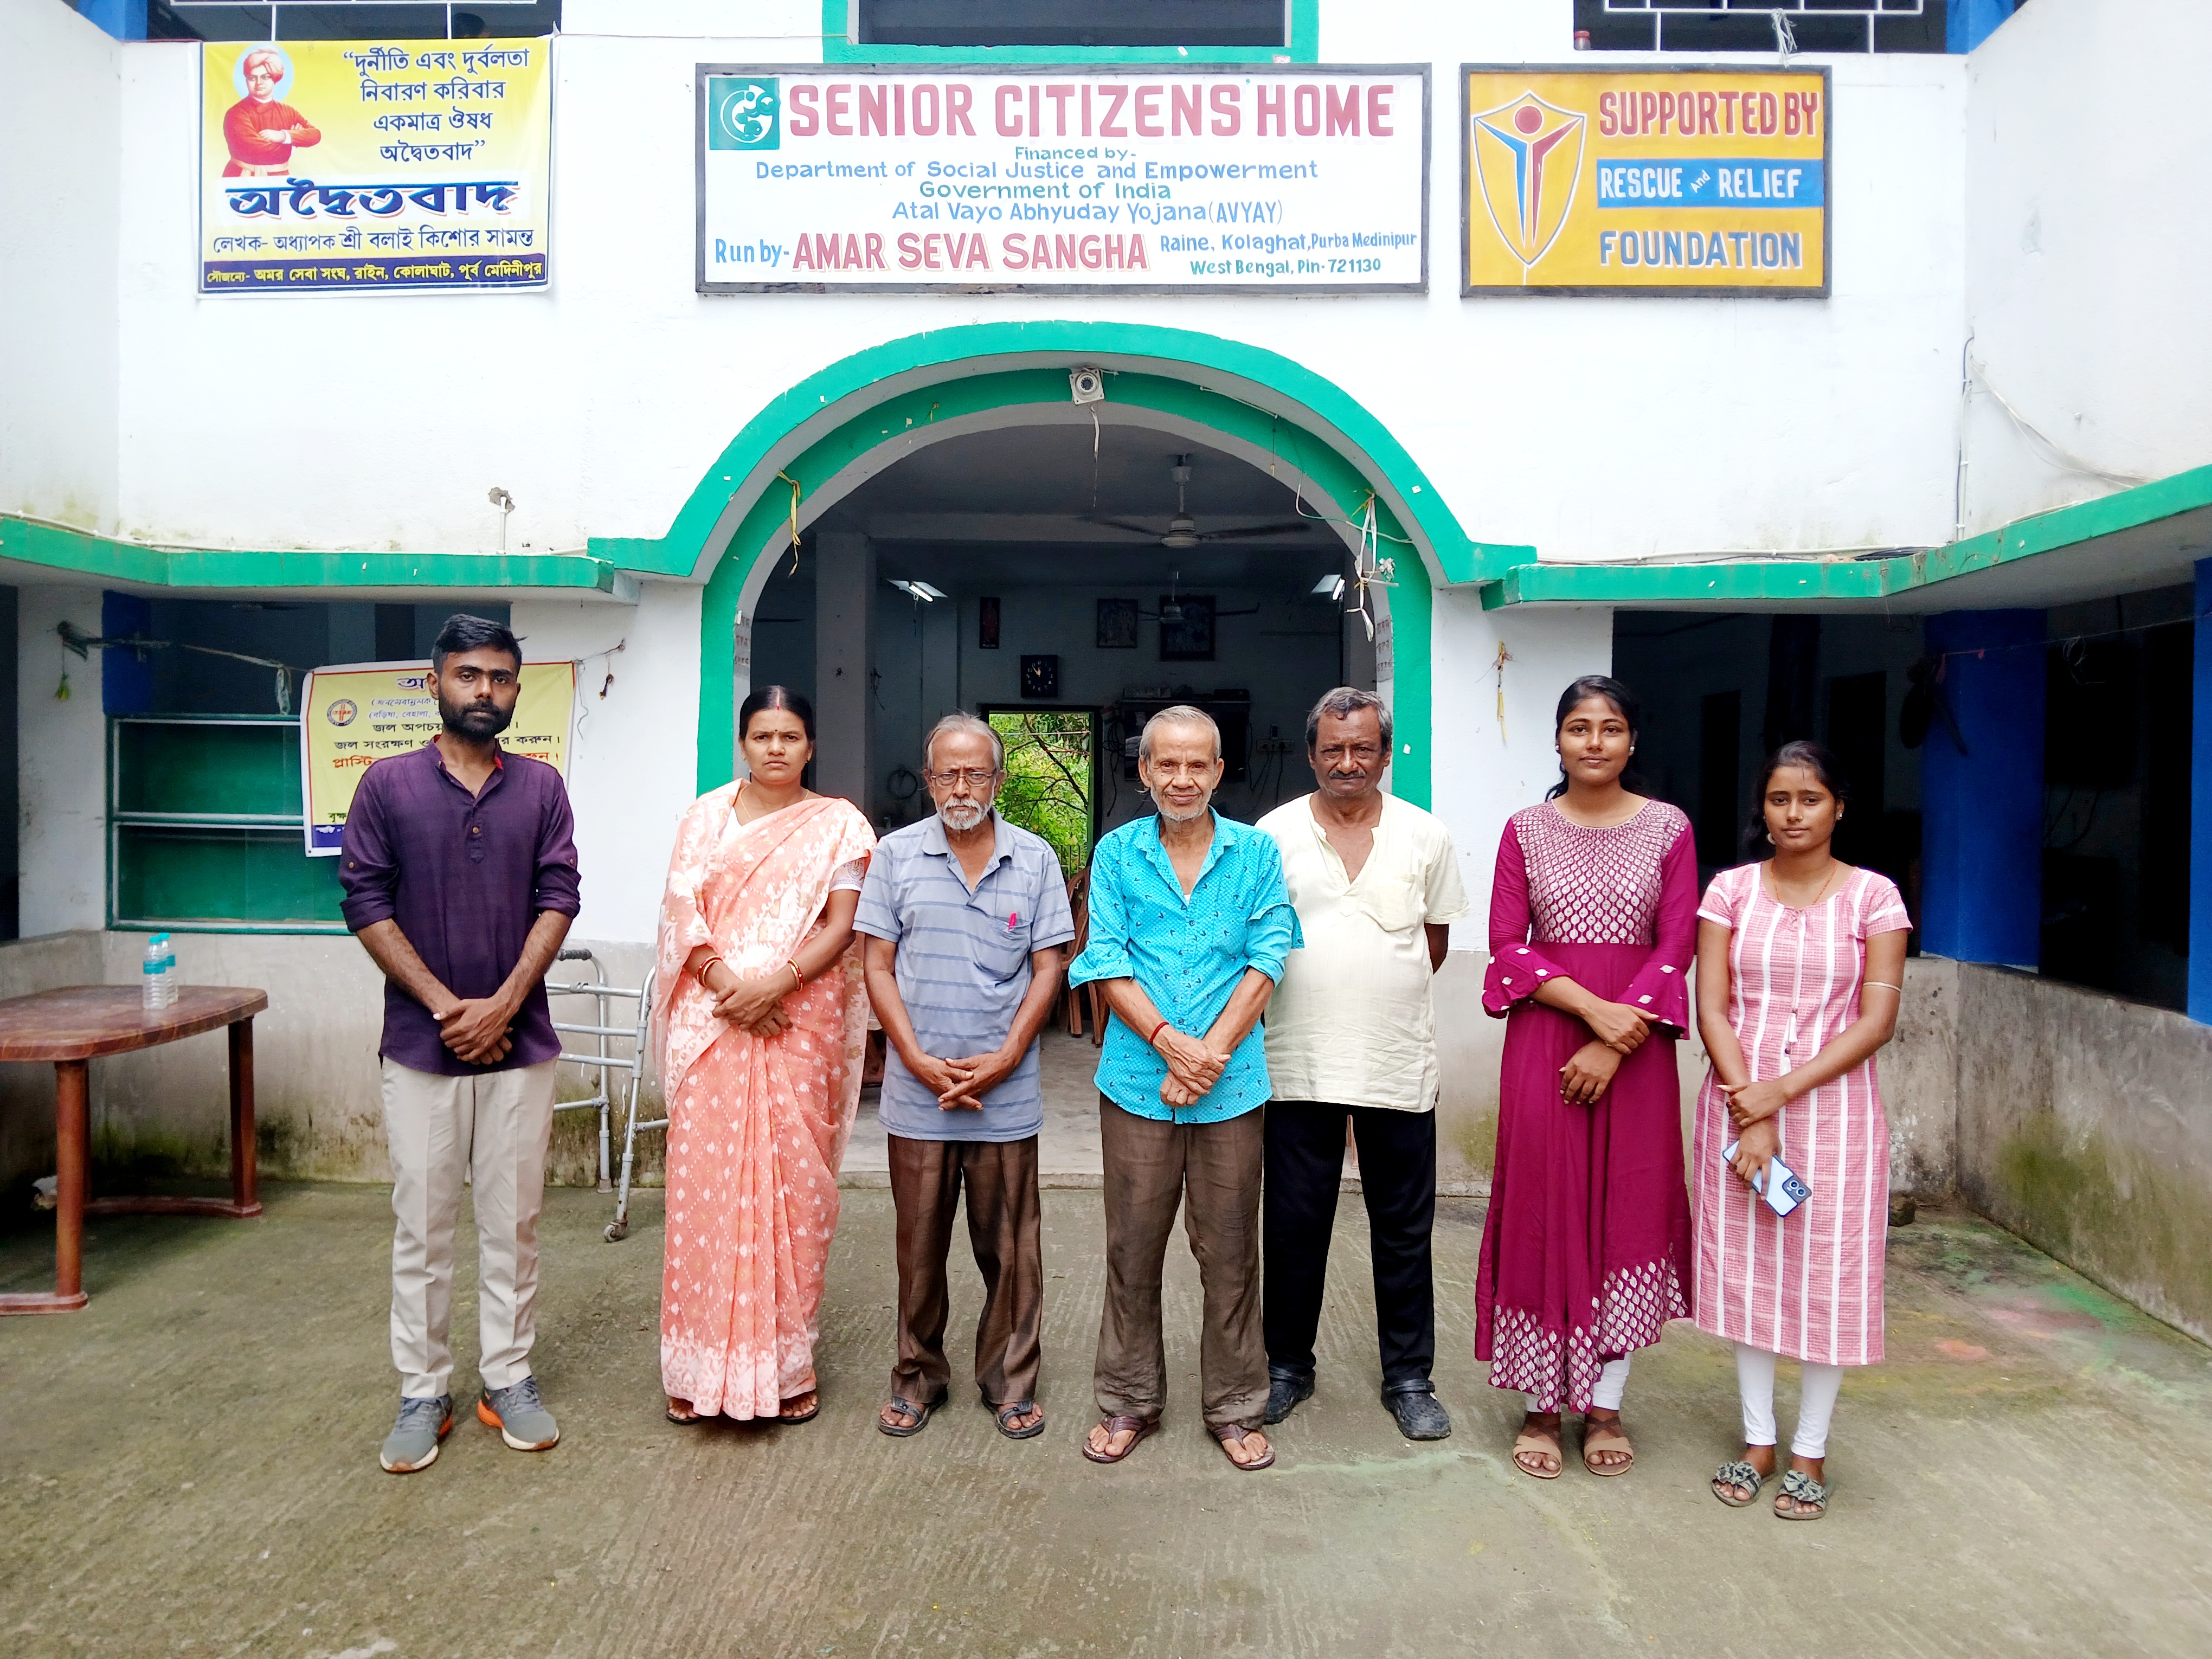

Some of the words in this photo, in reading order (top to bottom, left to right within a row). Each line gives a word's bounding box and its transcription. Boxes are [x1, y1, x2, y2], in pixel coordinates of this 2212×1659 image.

[416, 53, 456, 70] এবং
[462, 44, 530, 75] দুর্বলতা
[360, 79, 427, 101] নিবারণ
[434, 76, 506, 100] করিবার
[374, 112, 442, 131] একমাত্র
[449, 106, 493, 129] ঔষধ
[789, 83, 977, 137] SENIOR
[995, 83, 1241, 137] CITIZENS
[1257, 84, 1394, 137] HOME
[1599, 91, 1778, 137] SUPPORTED
[1784, 91, 1819, 137] BY
[380, 139, 485, 162] অদ্বৈতবাদ”
[1015, 146, 1098, 160] Financed
[756, 161, 889, 180] Department
[895, 161, 916, 177] of
[928, 162, 996, 177] Social
[1005, 162, 1084, 178] Justice
[1097, 162, 1136, 178] and
[1146, 160, 1319, 182] Empowerment
[1601, 168, 1683, 199] RESCUE
[1689, 170, 1711, 194] And
[1719, 169, 1802, 198] RELIEF
[225, 177, 519, 218] অদ্বৈতবাদ
[919, 181, 1070, 199] Government
[1079, 182, 1105, 199] of
[1115, 182, 1171, 199] India
[892, 202, 939, 219] Atal
[947, 202, 1002, 224] Vayo
[1009, 202, 1120, 224] Abhyuday
[214, 235, 268, 253] লেখক-
[273, 234, 336, 252] অধ্যাপক
[338, 226, 362, 249] শ্রী
[368, 226, 414, 251] বলাই
[417, 224, 480, 248] কিশোর
[484, 228, 535, 247] সামন্ত
[1599, 230, 1803, 269] FOUNDATION
[716, 239, 755, 263] Run
[792, 233, 889, 272] AMAR
[896, 232, 993, 272] SEVA
[1002, 232, 1150, 273] SANGHA
[1160, 235, 1215, 252] Raine,
[1352, 232, 1418, 249] Medinipur
[253, 268, 284, 281] অমর
[289, 267, 318, 281] সেবা
[320, 267, 350, 281] সংঘ,
[352, 262, 389, 281] রাইন,
[394, 261, 455, 280] কোলাঘাট,
[458, 260, 483, 280] পূর্ব
[485, 260, 543, 279] মেদিনীপুর
[1190, 260, 1232, 275] West
[1236, 260, 1294, 278] Bengal,
[372, 724, 397, 732] জল
[334, 741, 358, 750] জল
[363, 739, 414, 749] সংরক্ষণ
